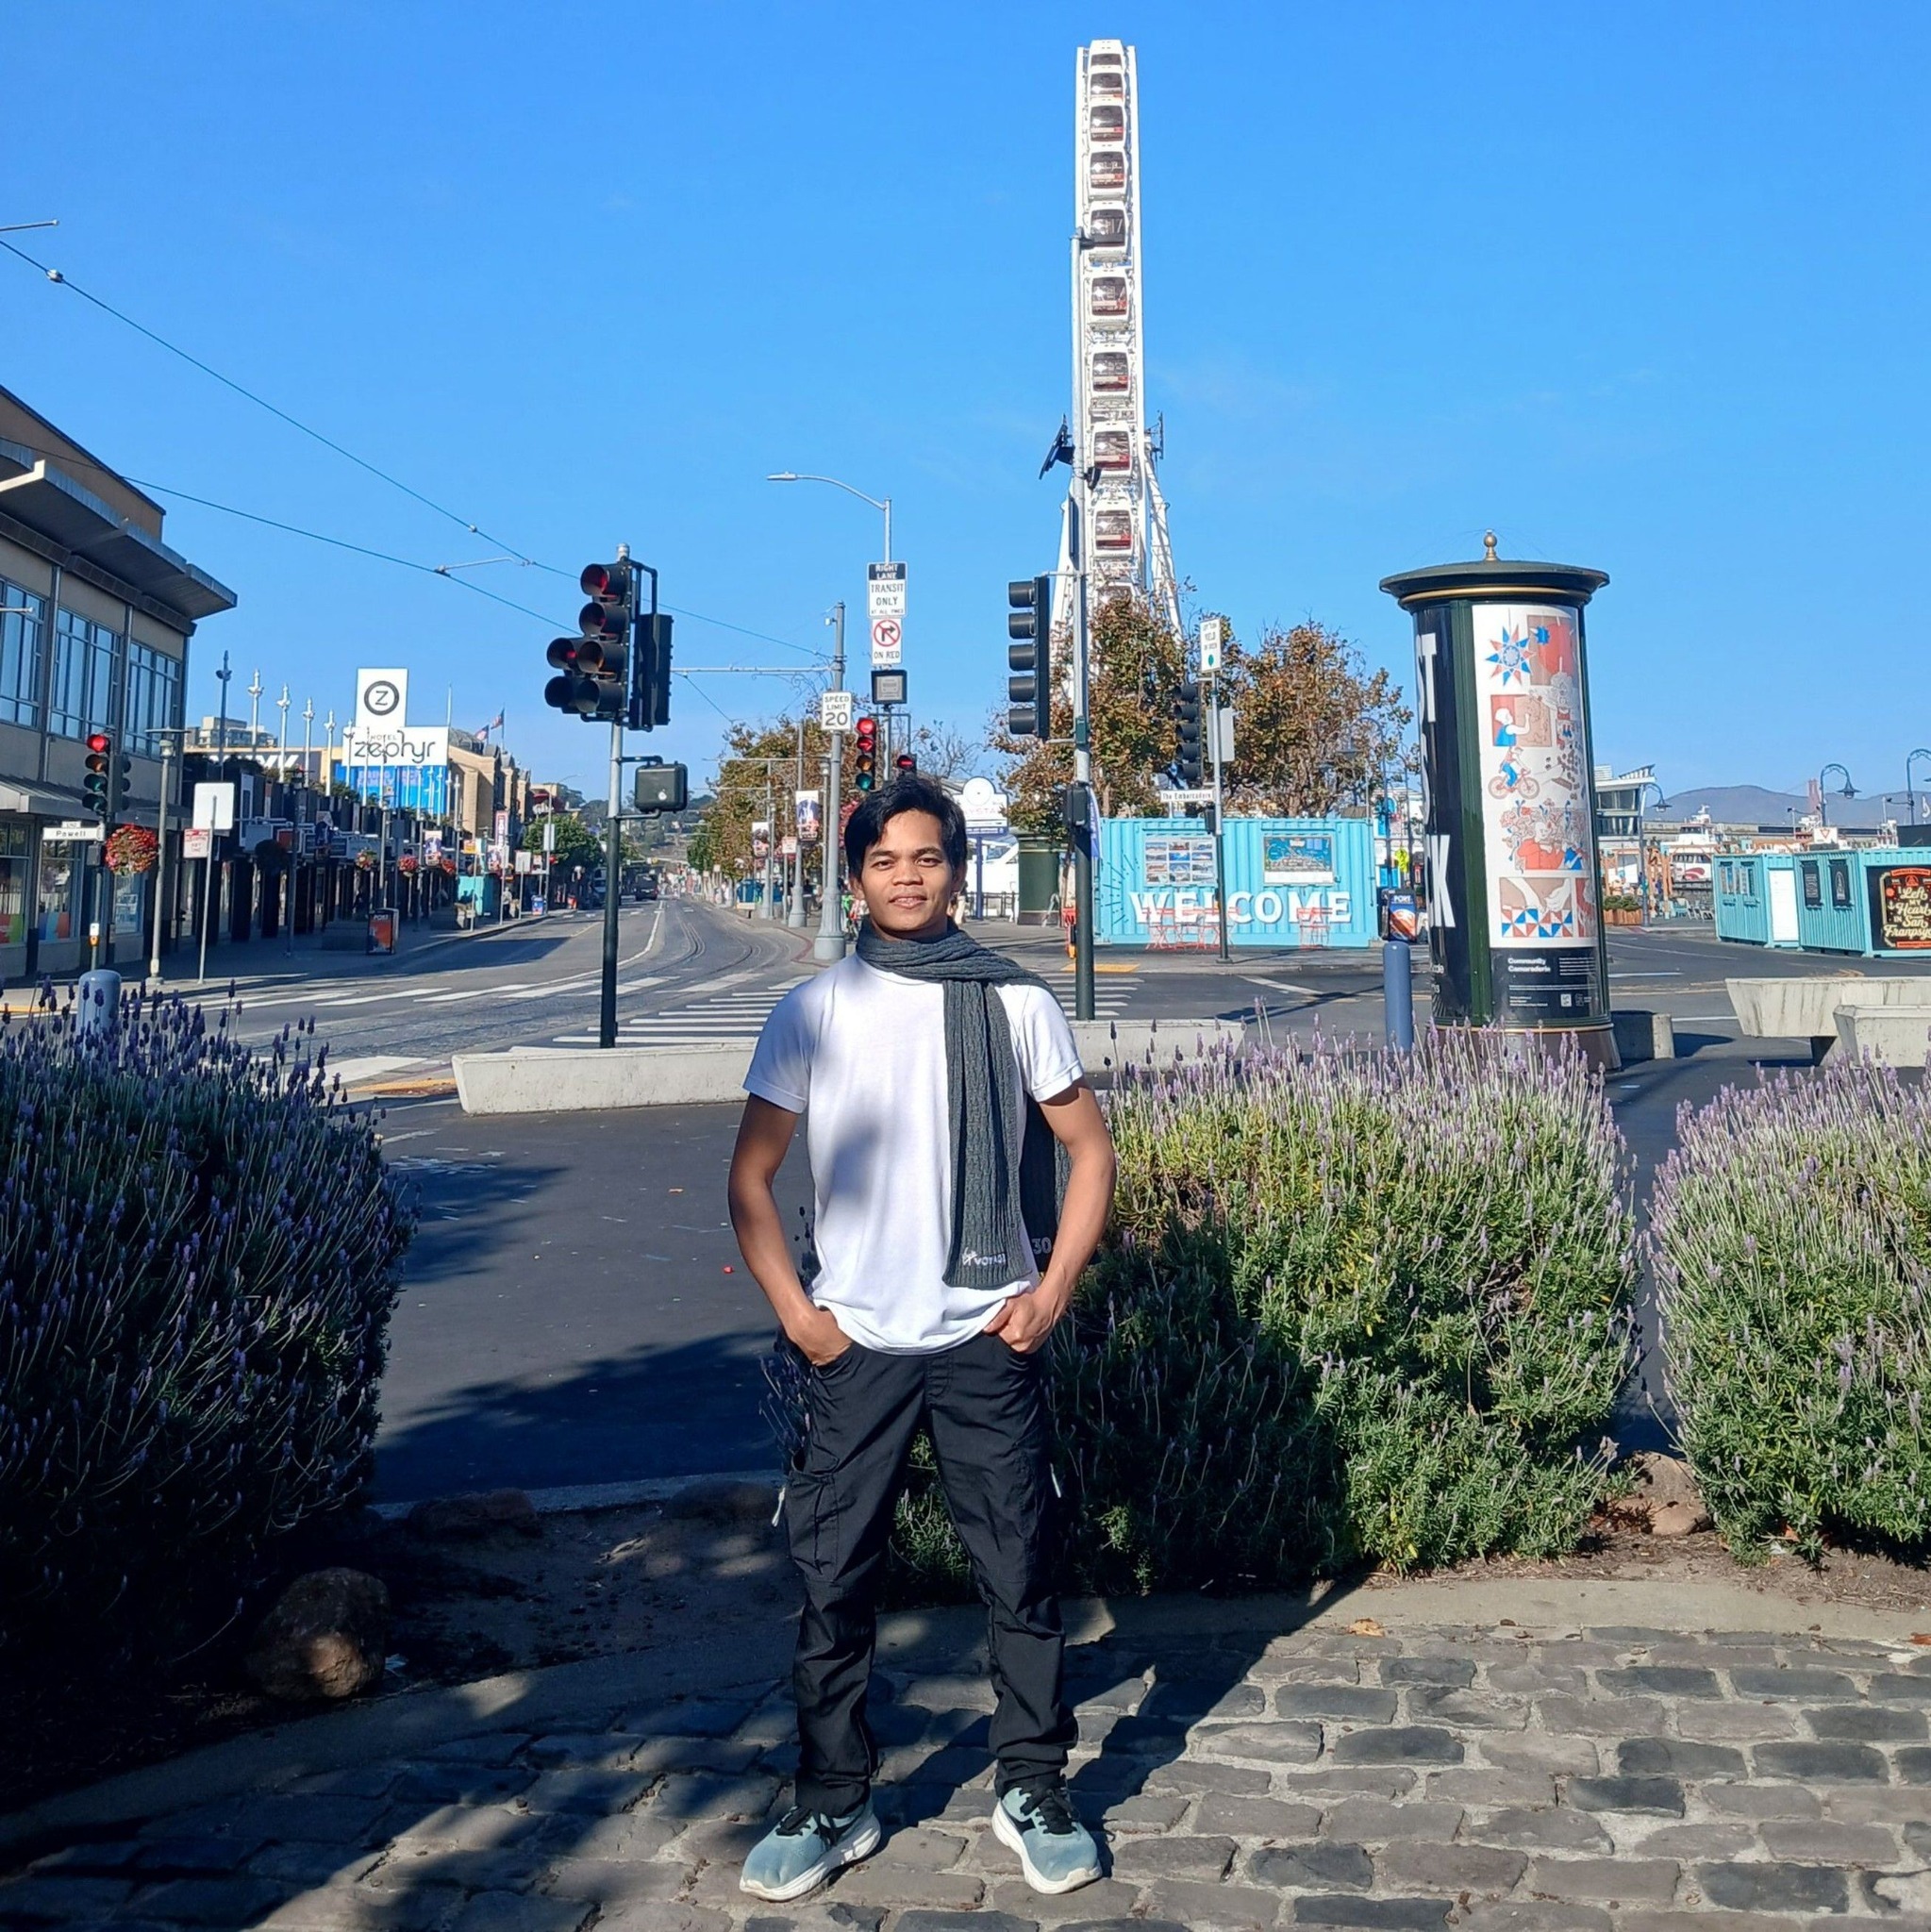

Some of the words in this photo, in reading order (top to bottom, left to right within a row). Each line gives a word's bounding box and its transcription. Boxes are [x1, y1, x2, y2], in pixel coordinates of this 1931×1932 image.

[871, 583, 904, 593] TRANSIT
[876, 596, 898, 606] ONLY
[874, 651, 884, 659] ON
[886, 650, 900, 659] RED
[824, 711, 848, 725] 20
[354, 729, 436, 764] zephyr
[1900, 887, 1928, 900] Left
[1129, 891, 1353, 924] WELCOME
[1903, 915, 1928, 927] San
[1031, 1237, 1052, 1255] 30
